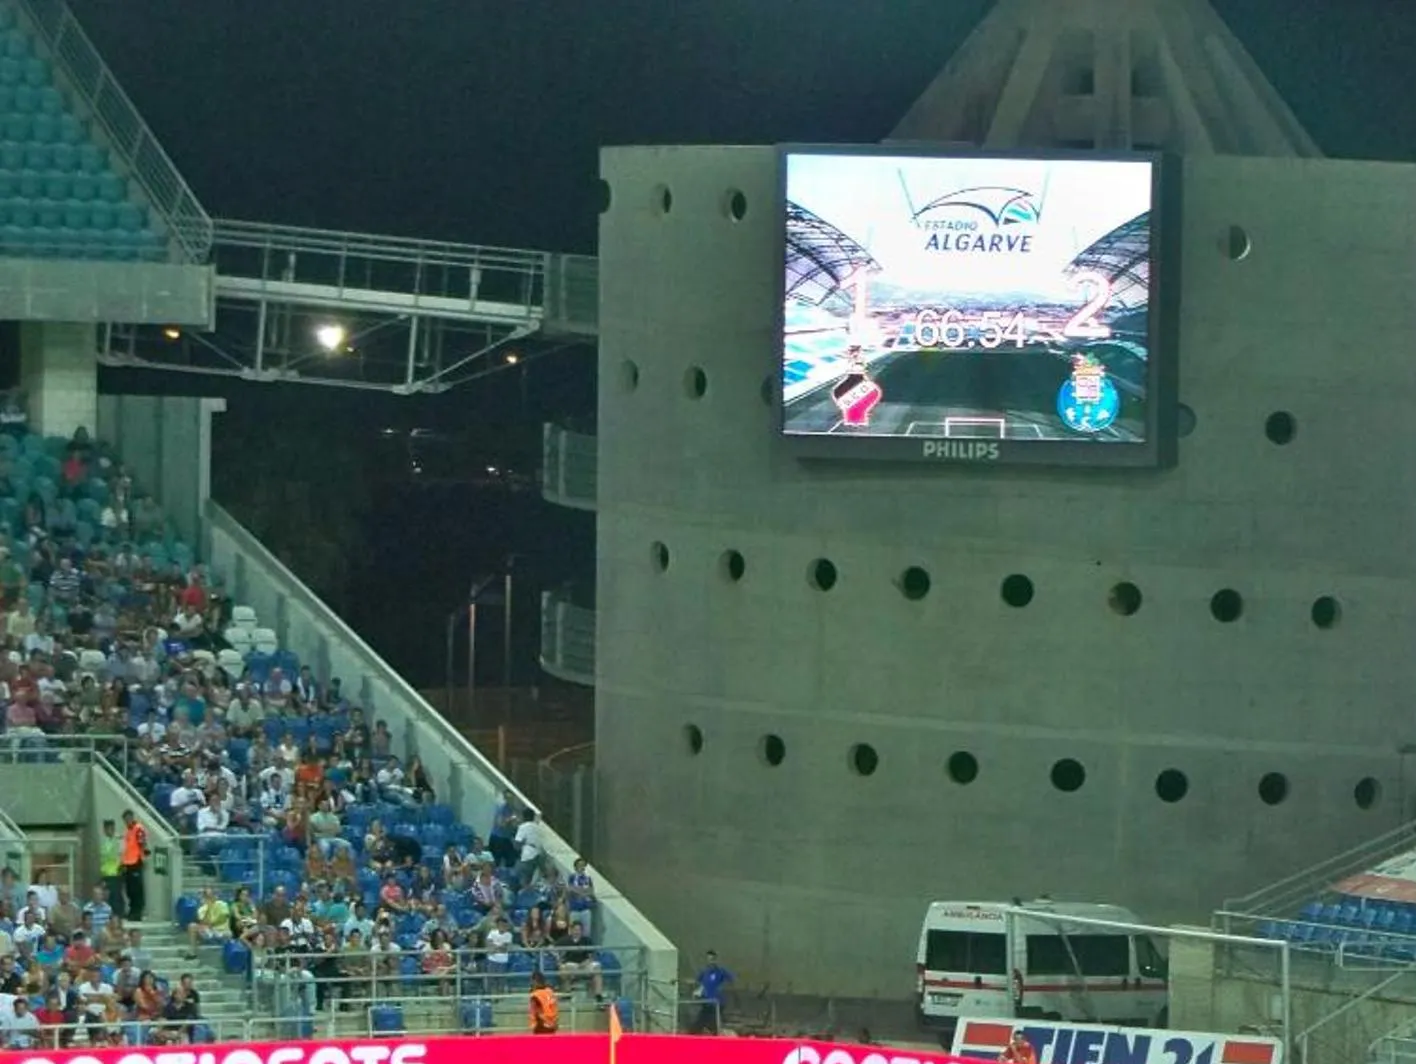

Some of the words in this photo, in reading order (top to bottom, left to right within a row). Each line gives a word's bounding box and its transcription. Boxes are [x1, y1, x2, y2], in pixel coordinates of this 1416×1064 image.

[924, 233, 1033, 252] ALGARVE
[1061, 271, 1112, 338] 2
[922, 440, 999, 459] PHILIPS
